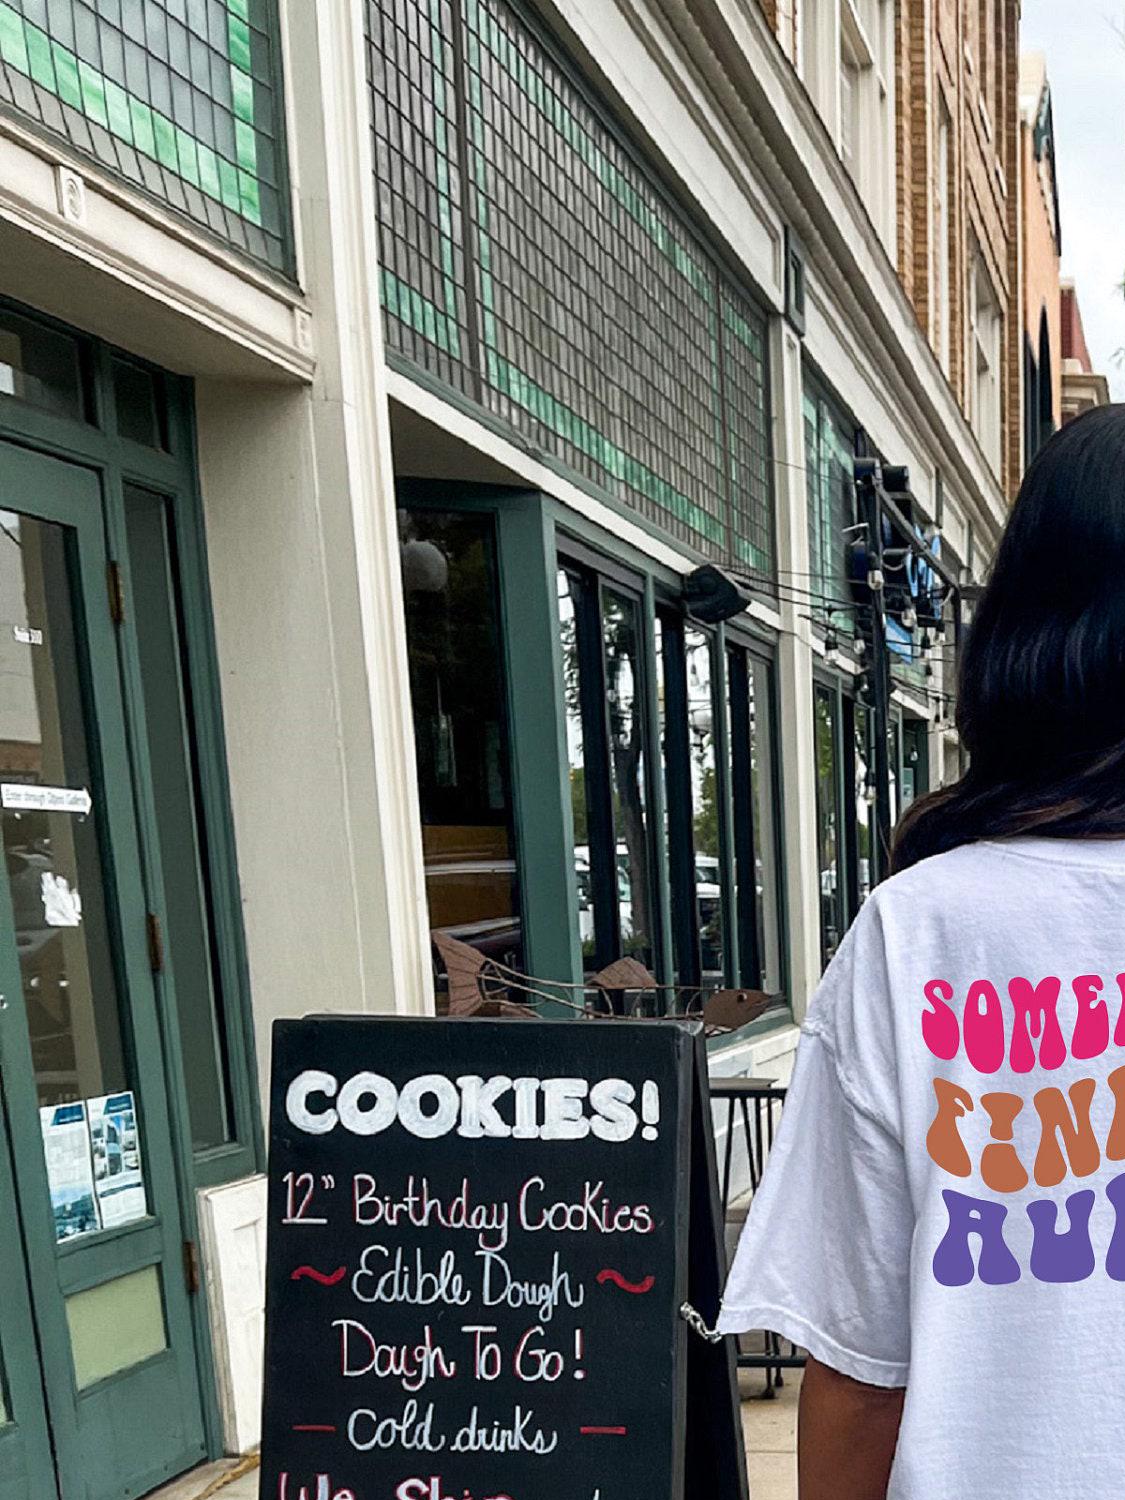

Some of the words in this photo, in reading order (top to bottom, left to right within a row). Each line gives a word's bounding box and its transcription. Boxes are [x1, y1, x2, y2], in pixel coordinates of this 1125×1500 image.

[285, 1069, 661, 1142] COOKIES!
[352, 1173, 509, 1252] Birthday
[351, 1244, 471, 1304] Edible
[474, 1250, 585, 1323] Dough
[461, 1325, 502, 1381] To
[346, 1398, 447, 1453] Cold
